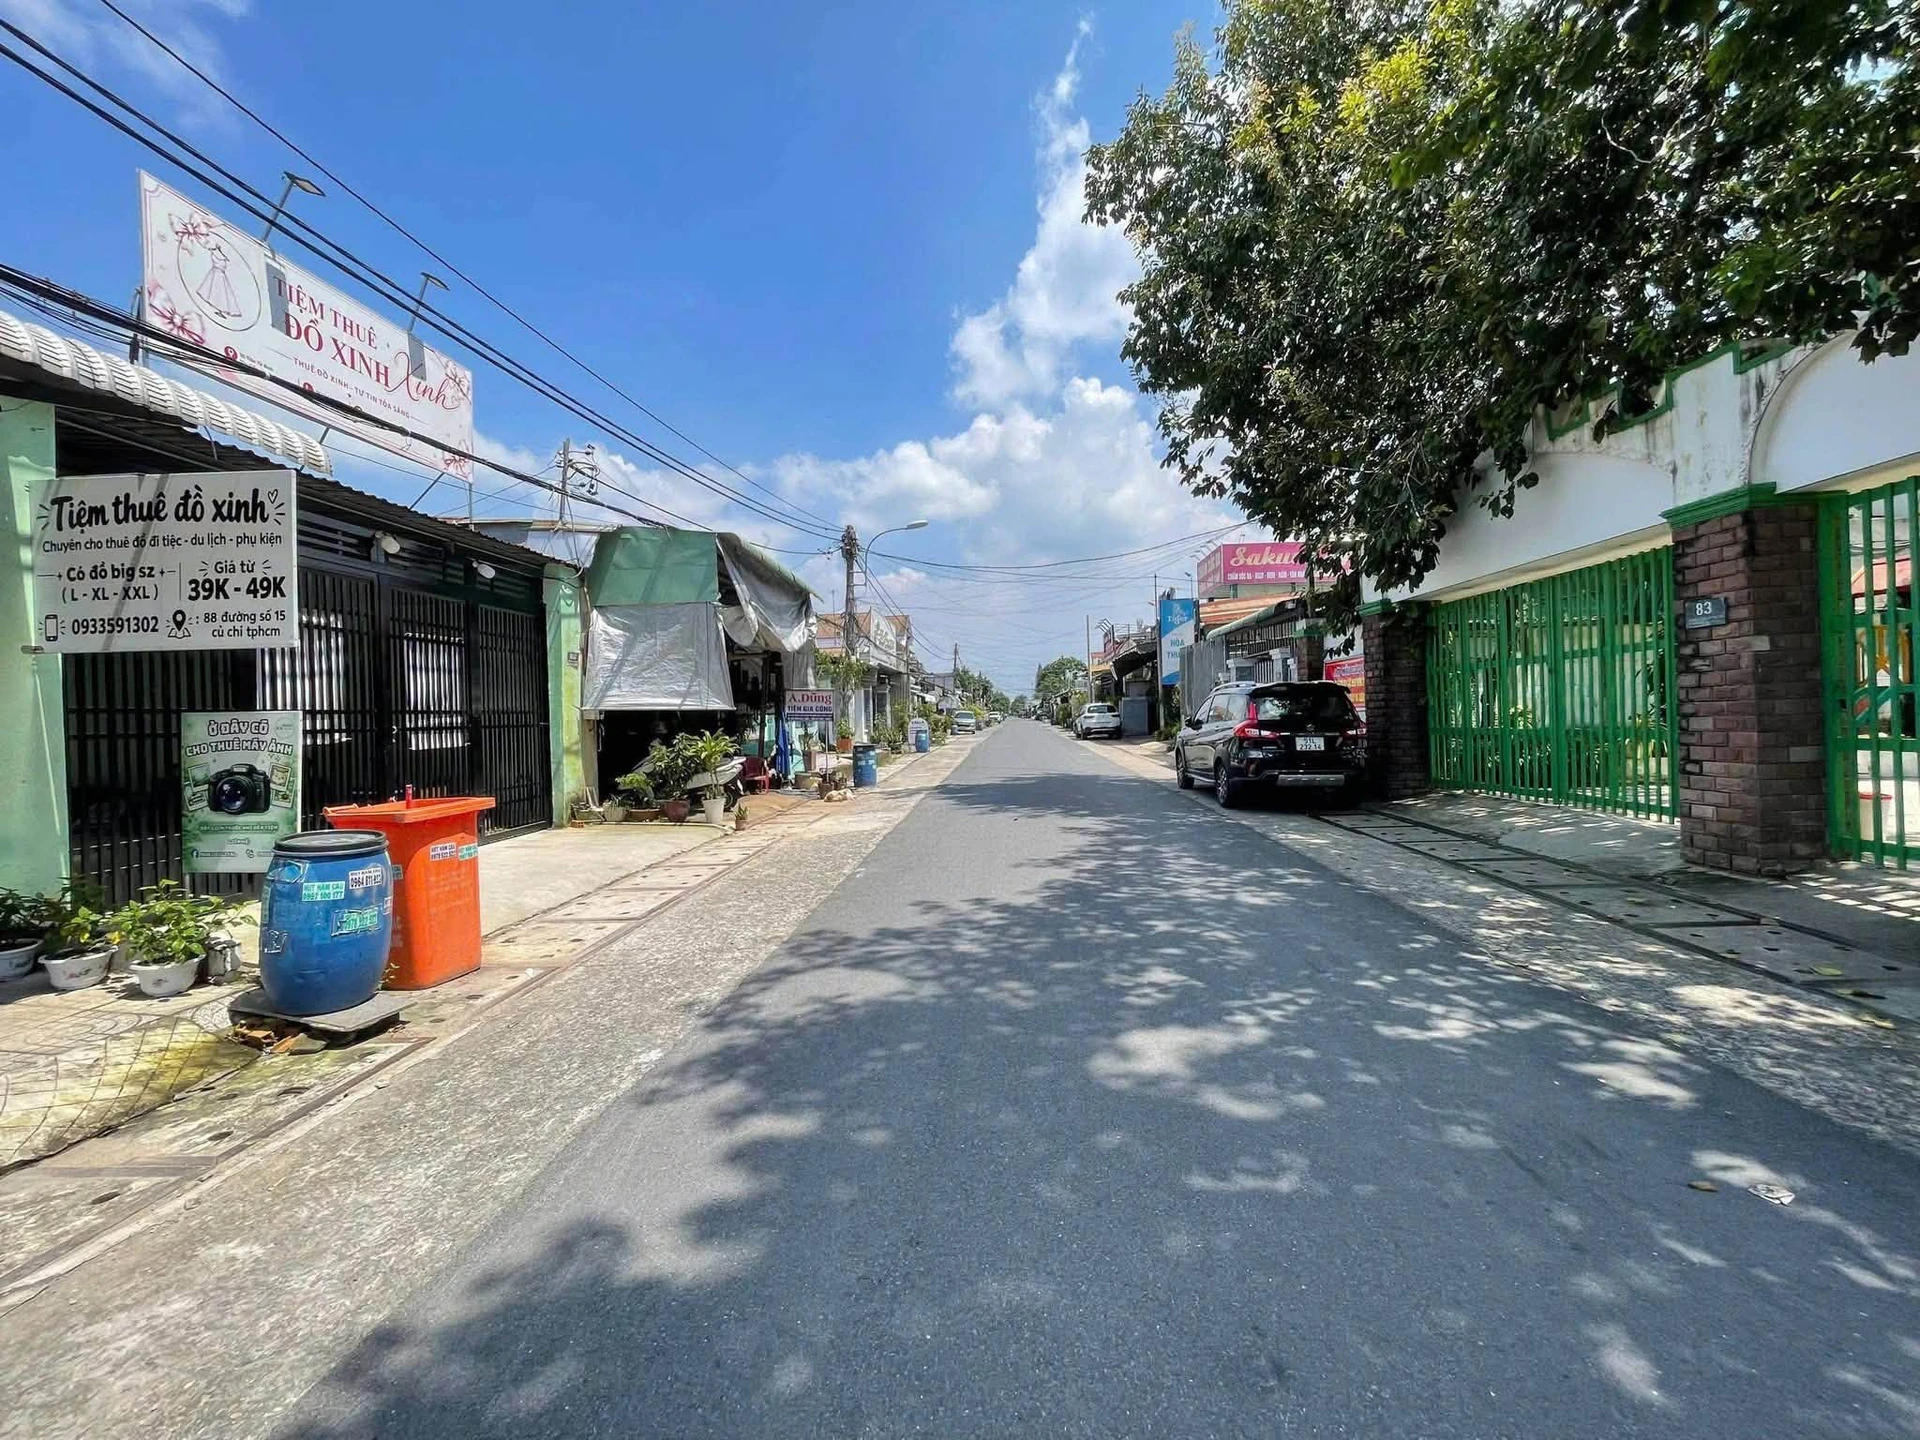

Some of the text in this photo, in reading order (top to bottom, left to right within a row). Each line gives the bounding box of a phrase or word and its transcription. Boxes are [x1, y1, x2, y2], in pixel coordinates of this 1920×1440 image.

[273, 275, 378, 349] TIỆM THUÊ
[285, 312, 324, 352] ĐỒ
[330, 336, 391, 388] XINH
[384, 351, 460, 410] Xinh
[330, 374, 349, 389] XINH
[366, 392, 377, 403] TIN
[50, 484, 269, 534] Tiệm thuê đồ xinh
[42, 538, 82, 553] Chuyên
[84, 537, 103, 550] cho
[105, 536, 130, 549] thuê
[149, 535, 159, 547] đi
[162, 534, 182, 549] tiệc
[190, 533, 205, 545] du
[207, 532, 226, 548] lịch
[236, 532, 257, 547] phụ
[259, 532, 282, 547] kiện
[1230, 546, 1301, 566] Saku
[66, 561, 155, 582] Có đồ big sz
[214, 559, 256, 574] Giá từ
[71, 588, 79, 601] L
[91, 587, 110, 601] XL
[122, 586, 150, 600] XXL
[187, 577, 230, 601] 39K
[245, 576, 286, 599] 49K
[203, 612, 217, 623] 88
[221, 610, 257, 624] đường
[259, 608, 272, 621] số
[274, 610, 286, 621] 15
[1696, 601, 1712, 616] 83
[71, 616, 159, 635] 0933591302
[211, 625, 224, 637] củ
[246, 625, 281, 640] tphcm
[208, 719, 219, 736] Ở
[219, 718, 249, 735] ĐÂY
[250, 718, 269, 735] CÓ
[185, 737, 293, 757] CHO THUÊ MÁY ẢNH
